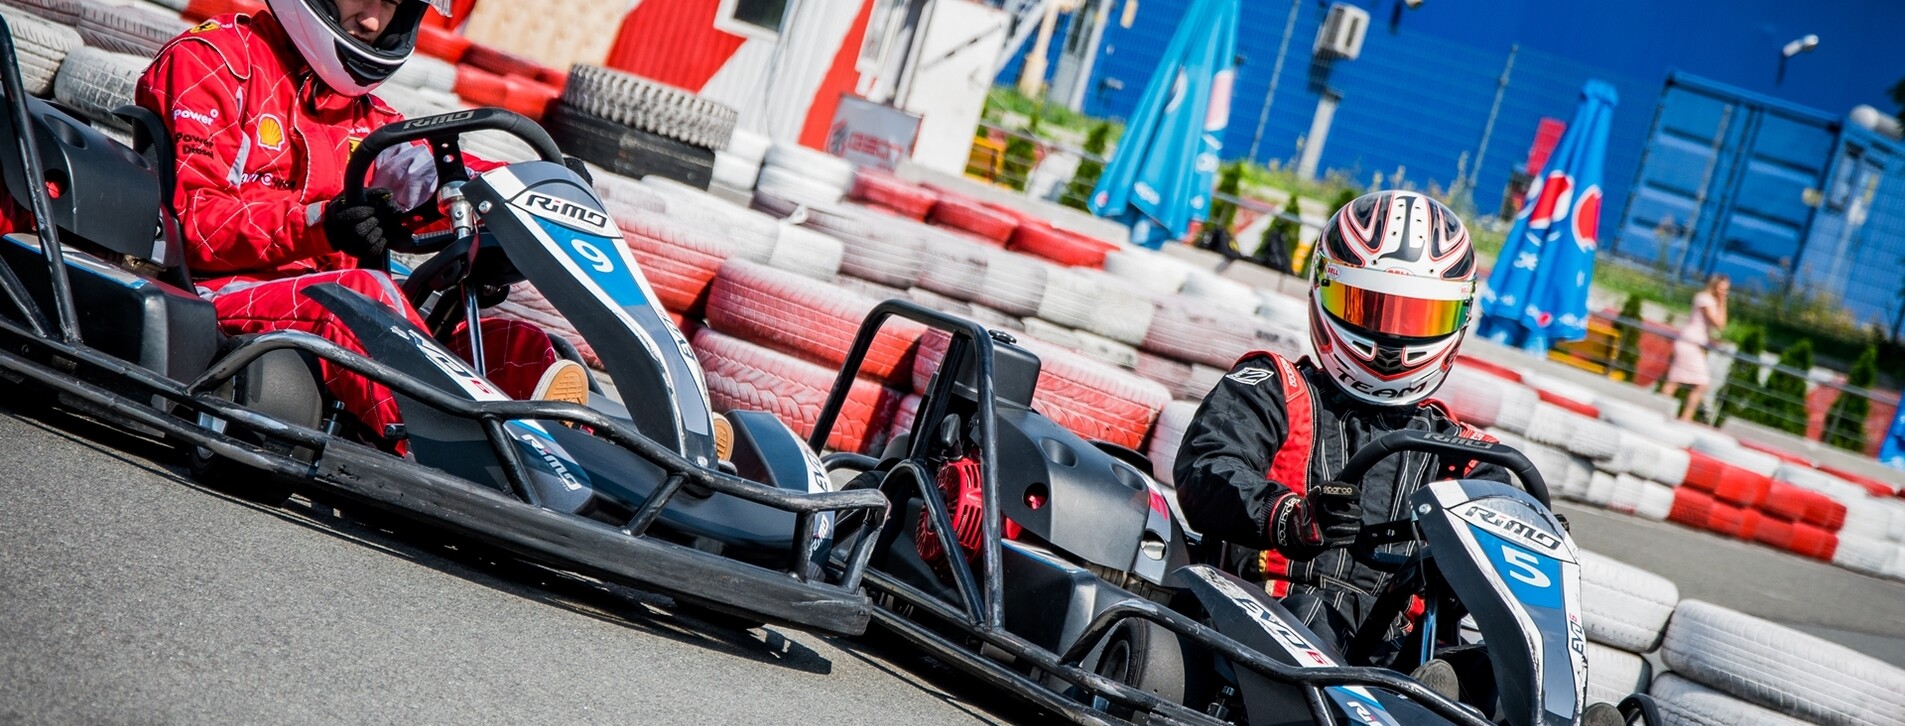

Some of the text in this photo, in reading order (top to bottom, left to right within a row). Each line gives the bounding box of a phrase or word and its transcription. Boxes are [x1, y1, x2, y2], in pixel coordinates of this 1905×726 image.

[570, 238, 615, 274] 9
[1336, 366, 1428, 398] TEAM
[1277, 496, 1301, 547] sparco
[1501, 544, 1552, 588] 5
